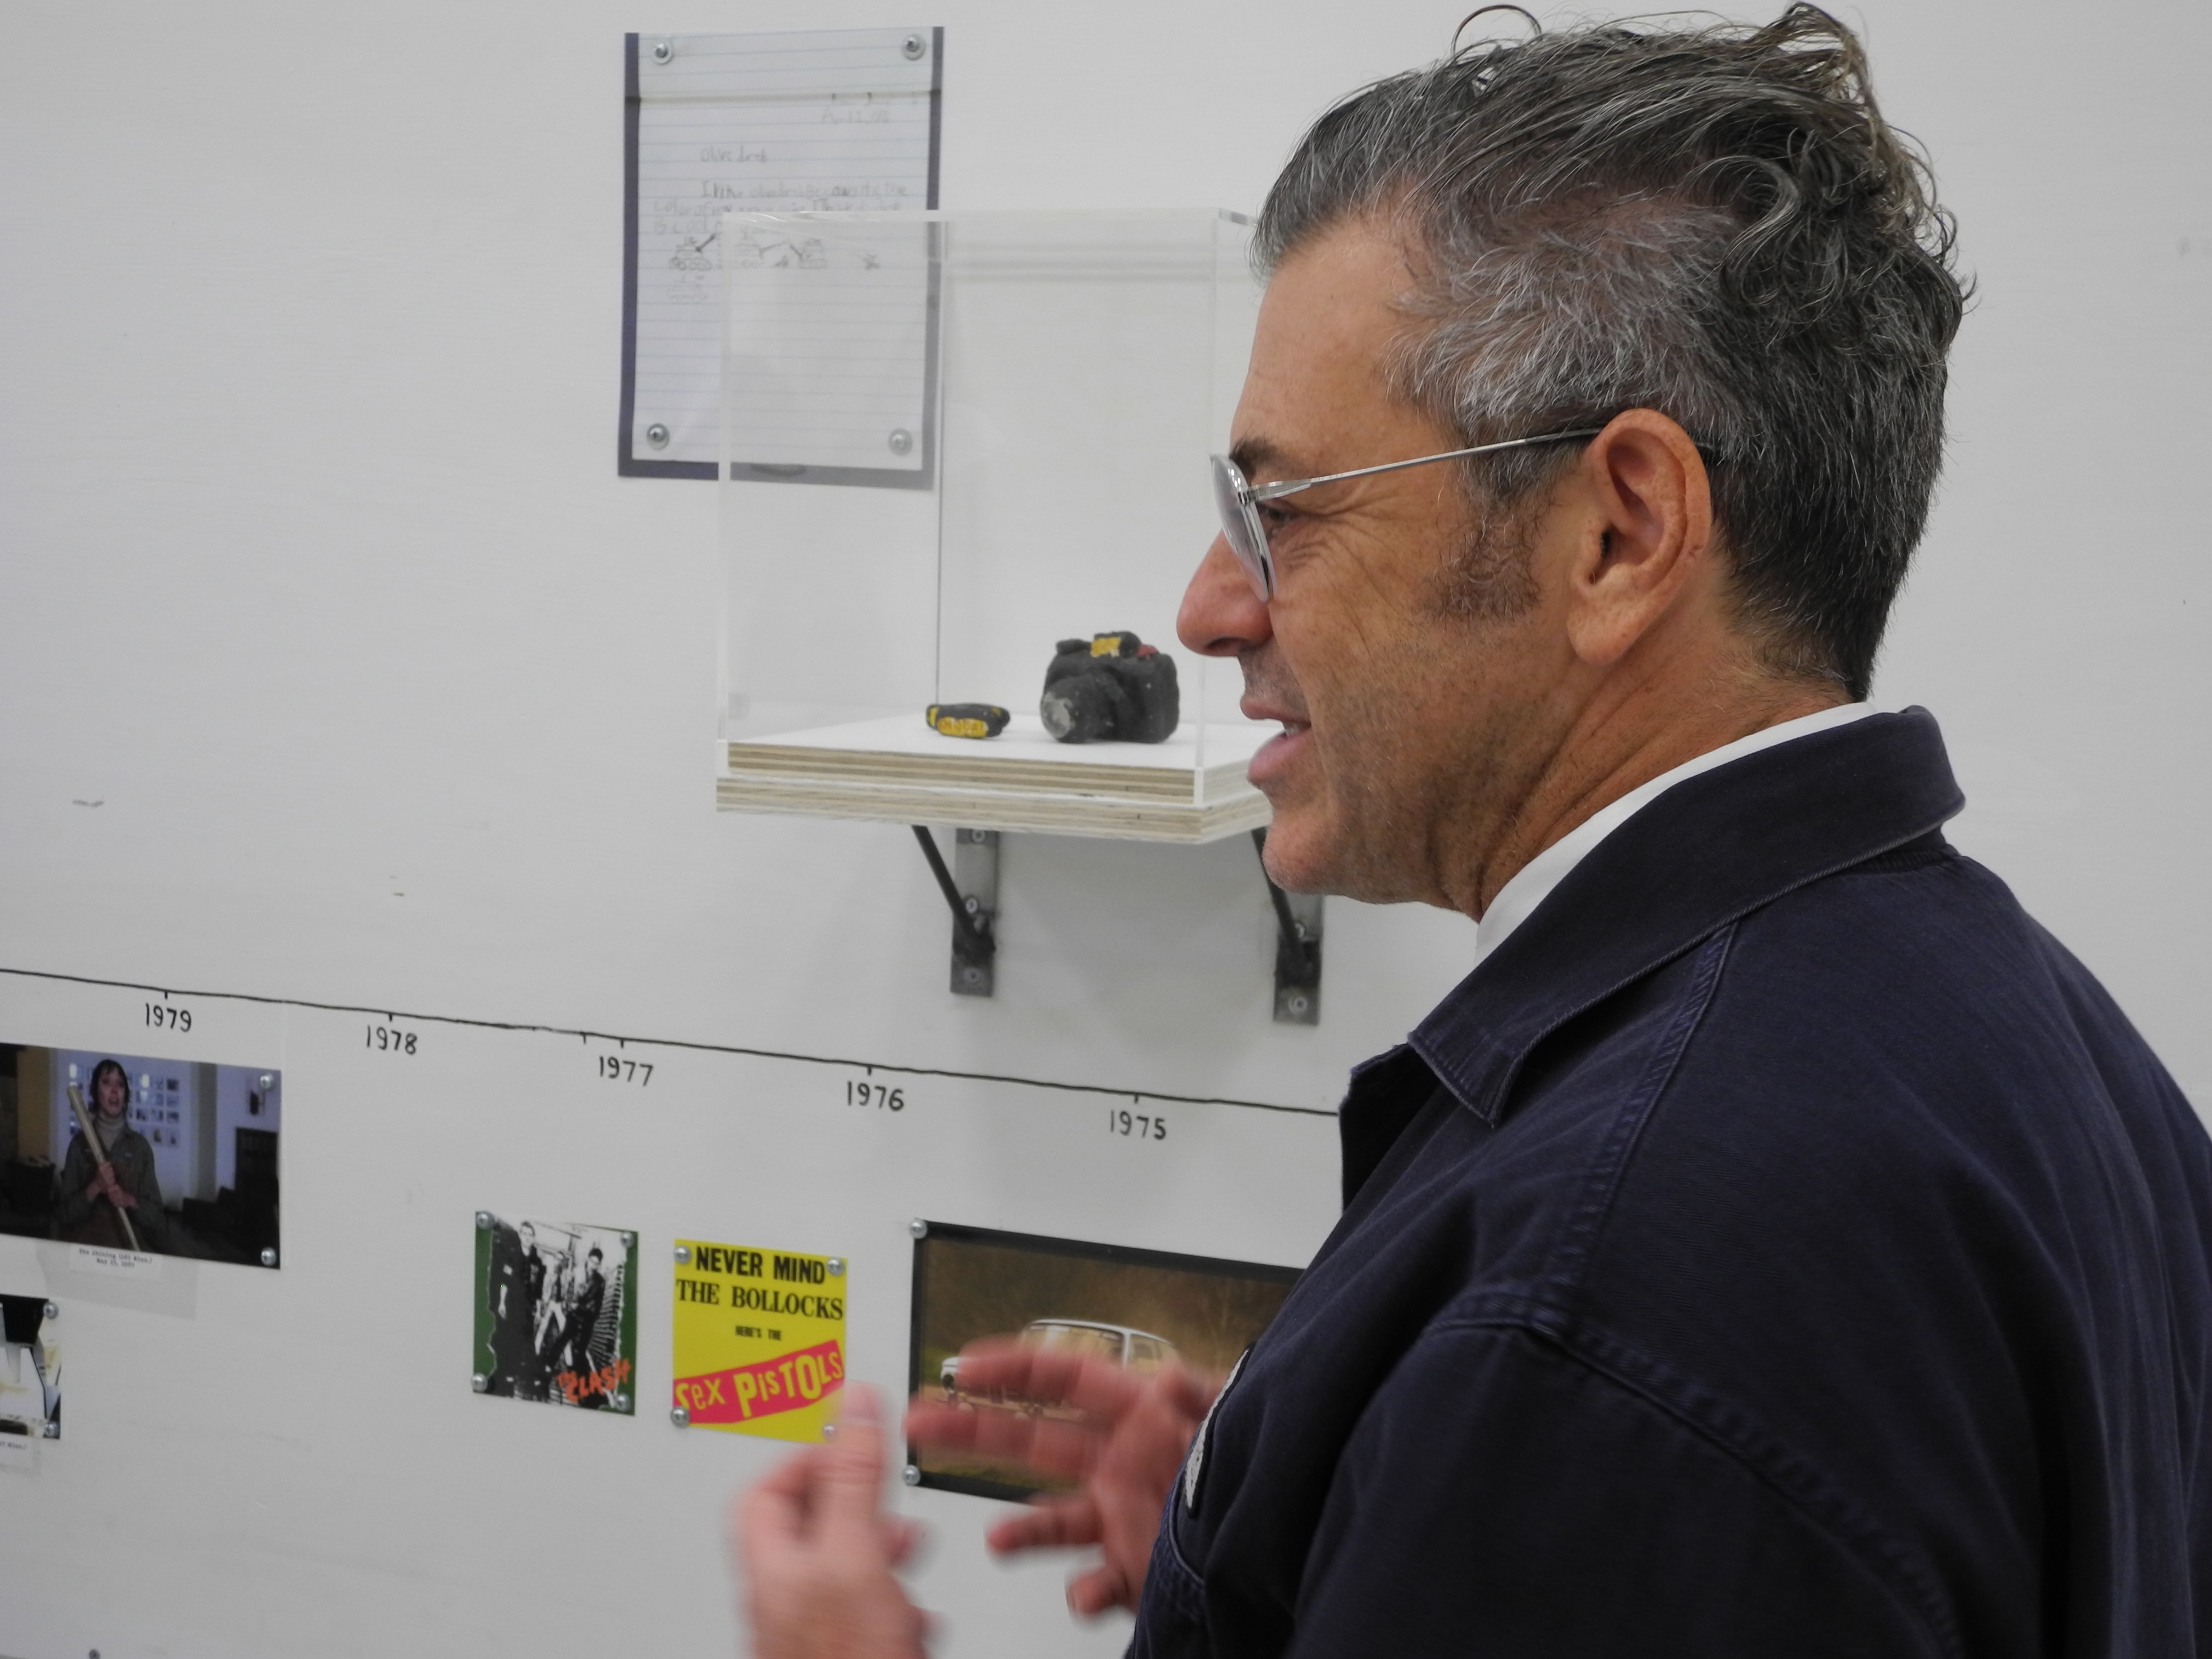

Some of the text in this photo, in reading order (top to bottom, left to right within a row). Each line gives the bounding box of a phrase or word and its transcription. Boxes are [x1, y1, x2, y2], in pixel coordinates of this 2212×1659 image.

[146, 1002, 192, 1032] 1979
[366, 1025, 418, 1055] 1978
[599, 1056, 654, 1086] 1977
[848, 1081, 905, 1111] 1976
[1110, 1110, 1167, 1140] 1975
[695, 1246, 825, 1284] NEVER MIND
[676, 1279, 843, 1320] THE BOLLOCKS
[565, 1358, 631, 1403] CLASH
